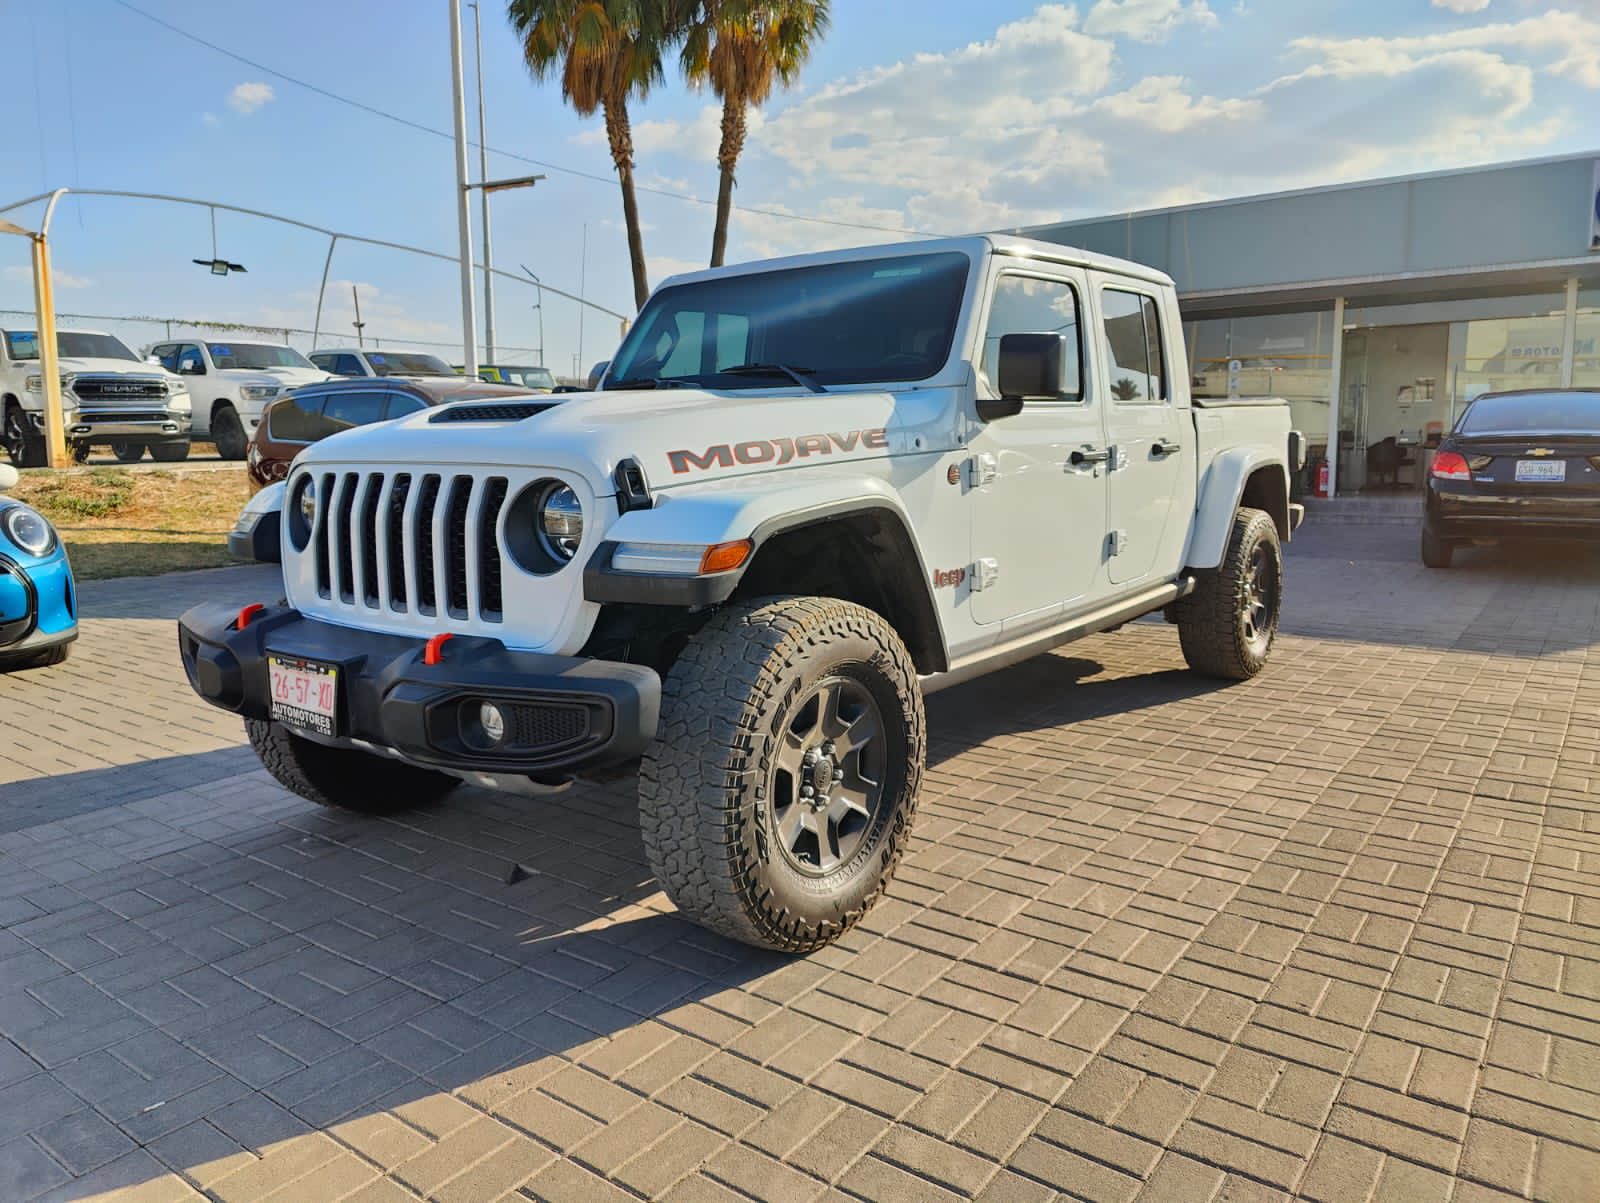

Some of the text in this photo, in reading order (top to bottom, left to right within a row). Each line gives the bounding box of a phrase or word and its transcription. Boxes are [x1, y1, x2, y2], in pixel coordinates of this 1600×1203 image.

[666, 428, 889, 474] MOJAVE
[934, 567, 965, 588] Jeep
[272, 702, 331, 729] AUTOMOTORES
